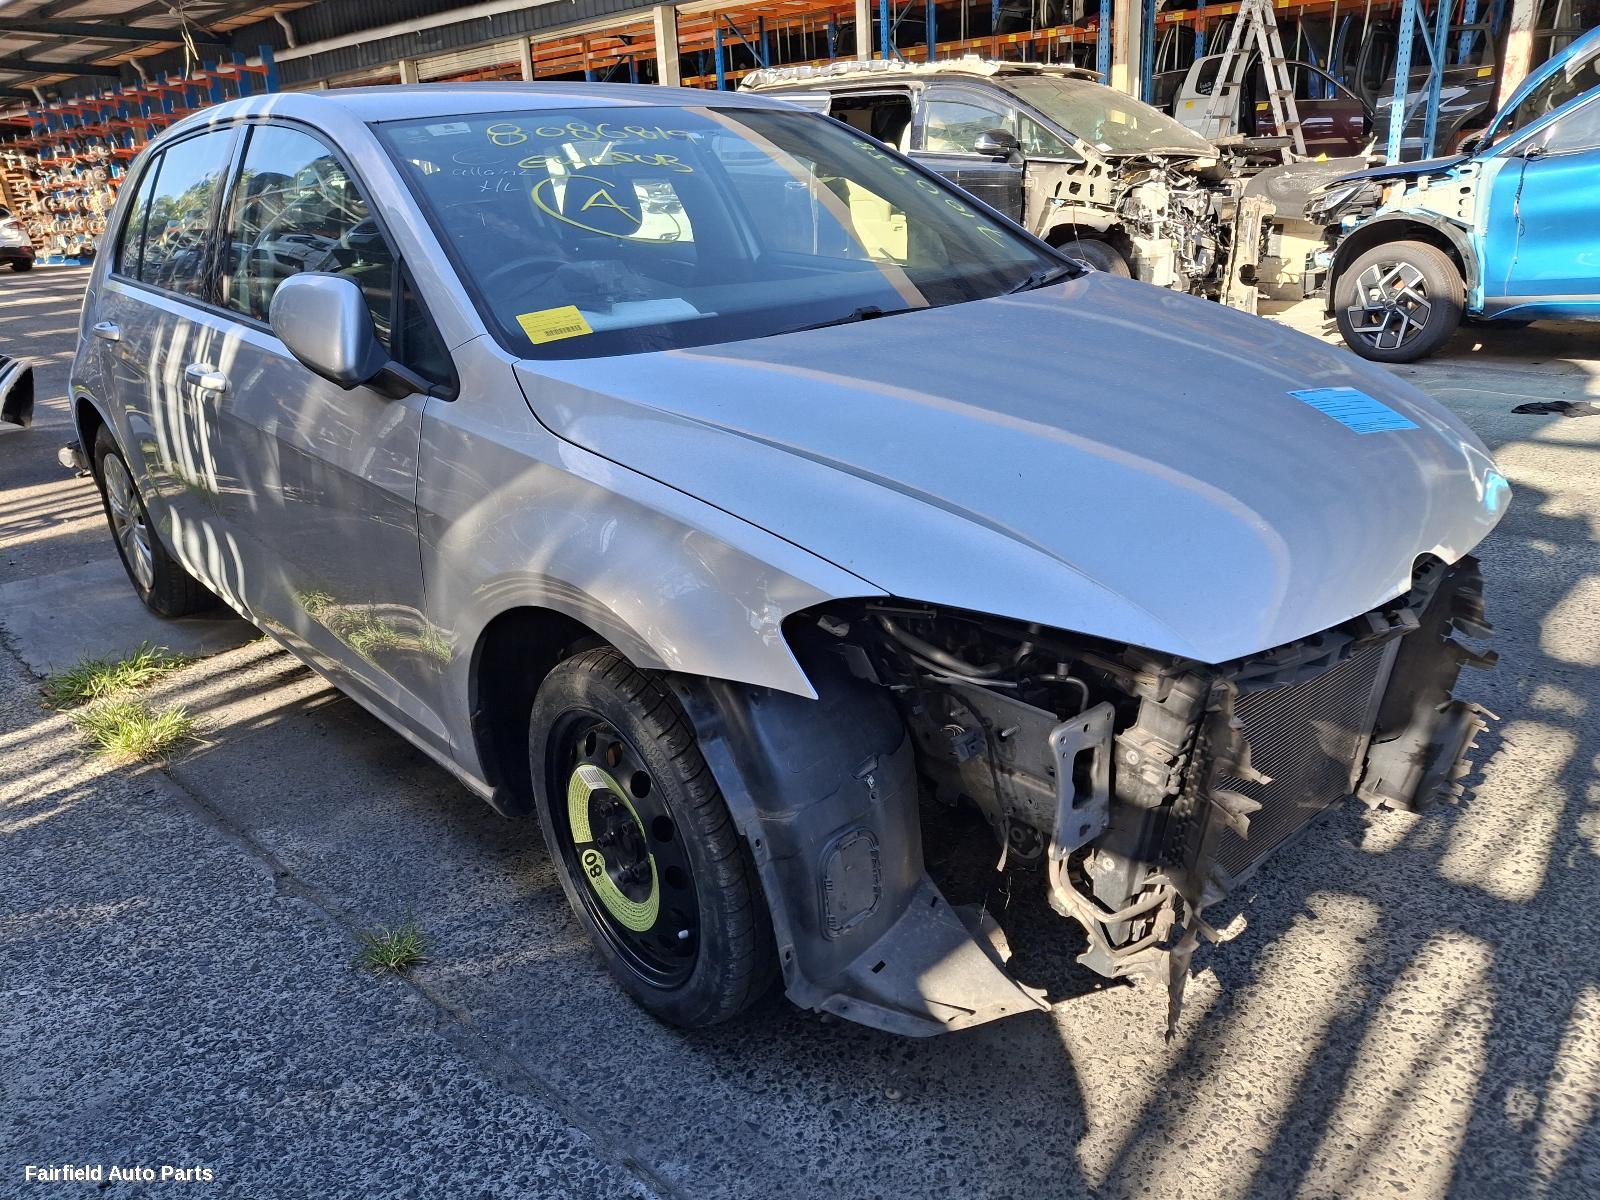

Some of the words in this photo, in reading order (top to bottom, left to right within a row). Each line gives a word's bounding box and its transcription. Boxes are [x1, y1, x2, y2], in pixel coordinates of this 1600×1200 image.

[486, 123, 697, 146] 8086819
[580, 188, 643, 226] A
[584, 852, 603, 879] 80
